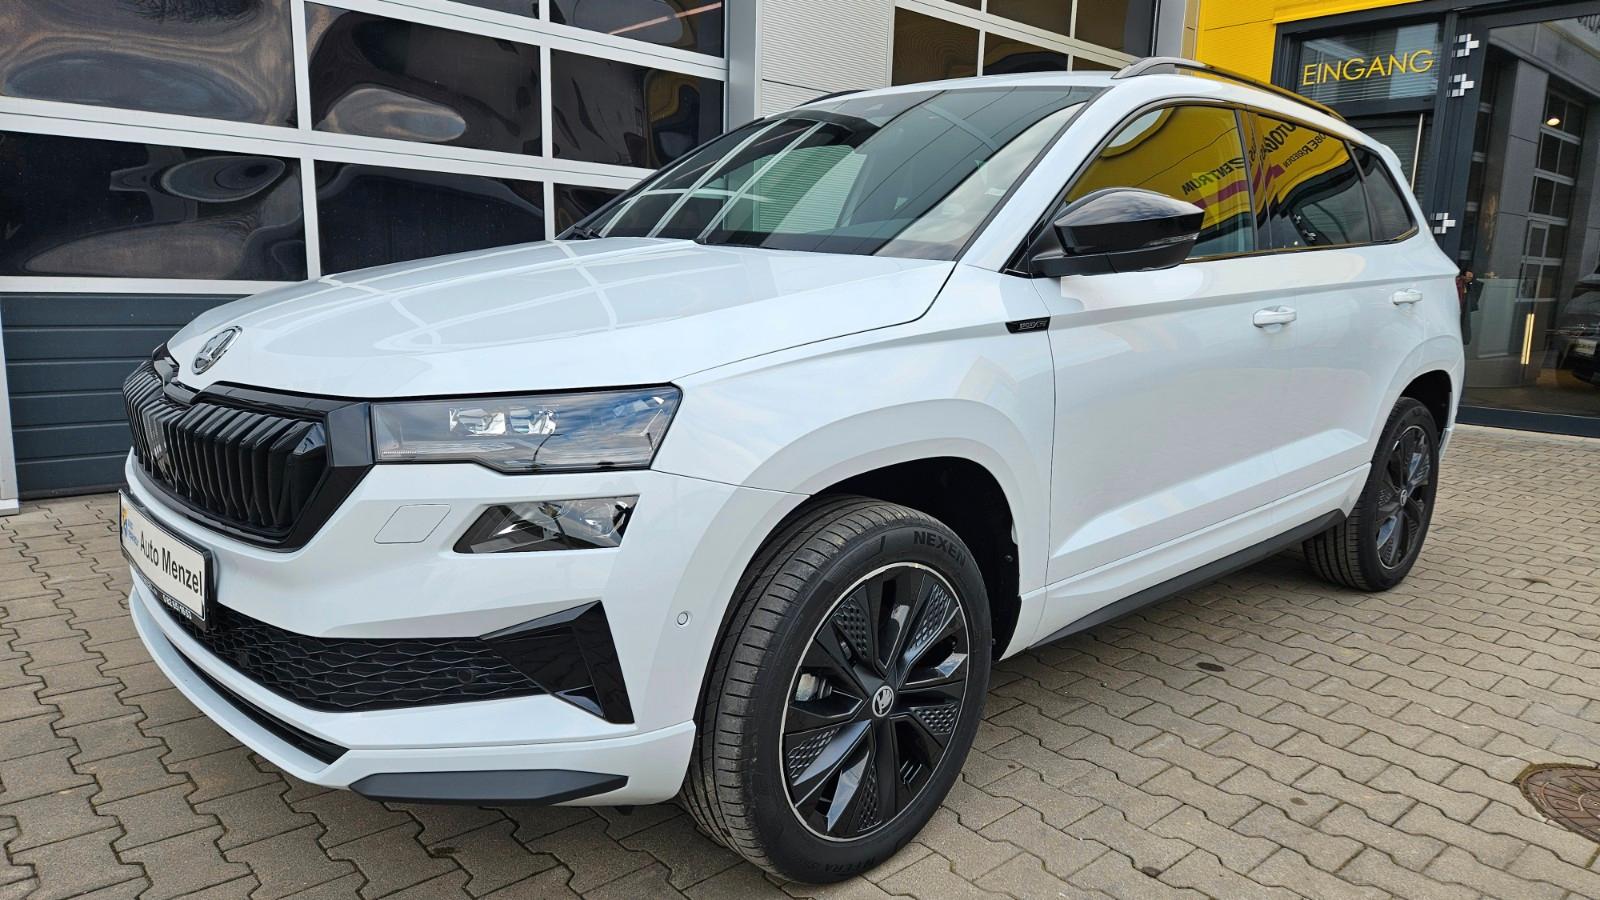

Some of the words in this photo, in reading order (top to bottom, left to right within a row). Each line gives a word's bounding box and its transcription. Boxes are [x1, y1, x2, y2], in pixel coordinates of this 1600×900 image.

[1302, 49, 1434, 86] EINGANG
[140, 530, 160, 567] Auto
[161, 546, 203, 597] Menzel
[913, 530, 966, 567] NEXEN
